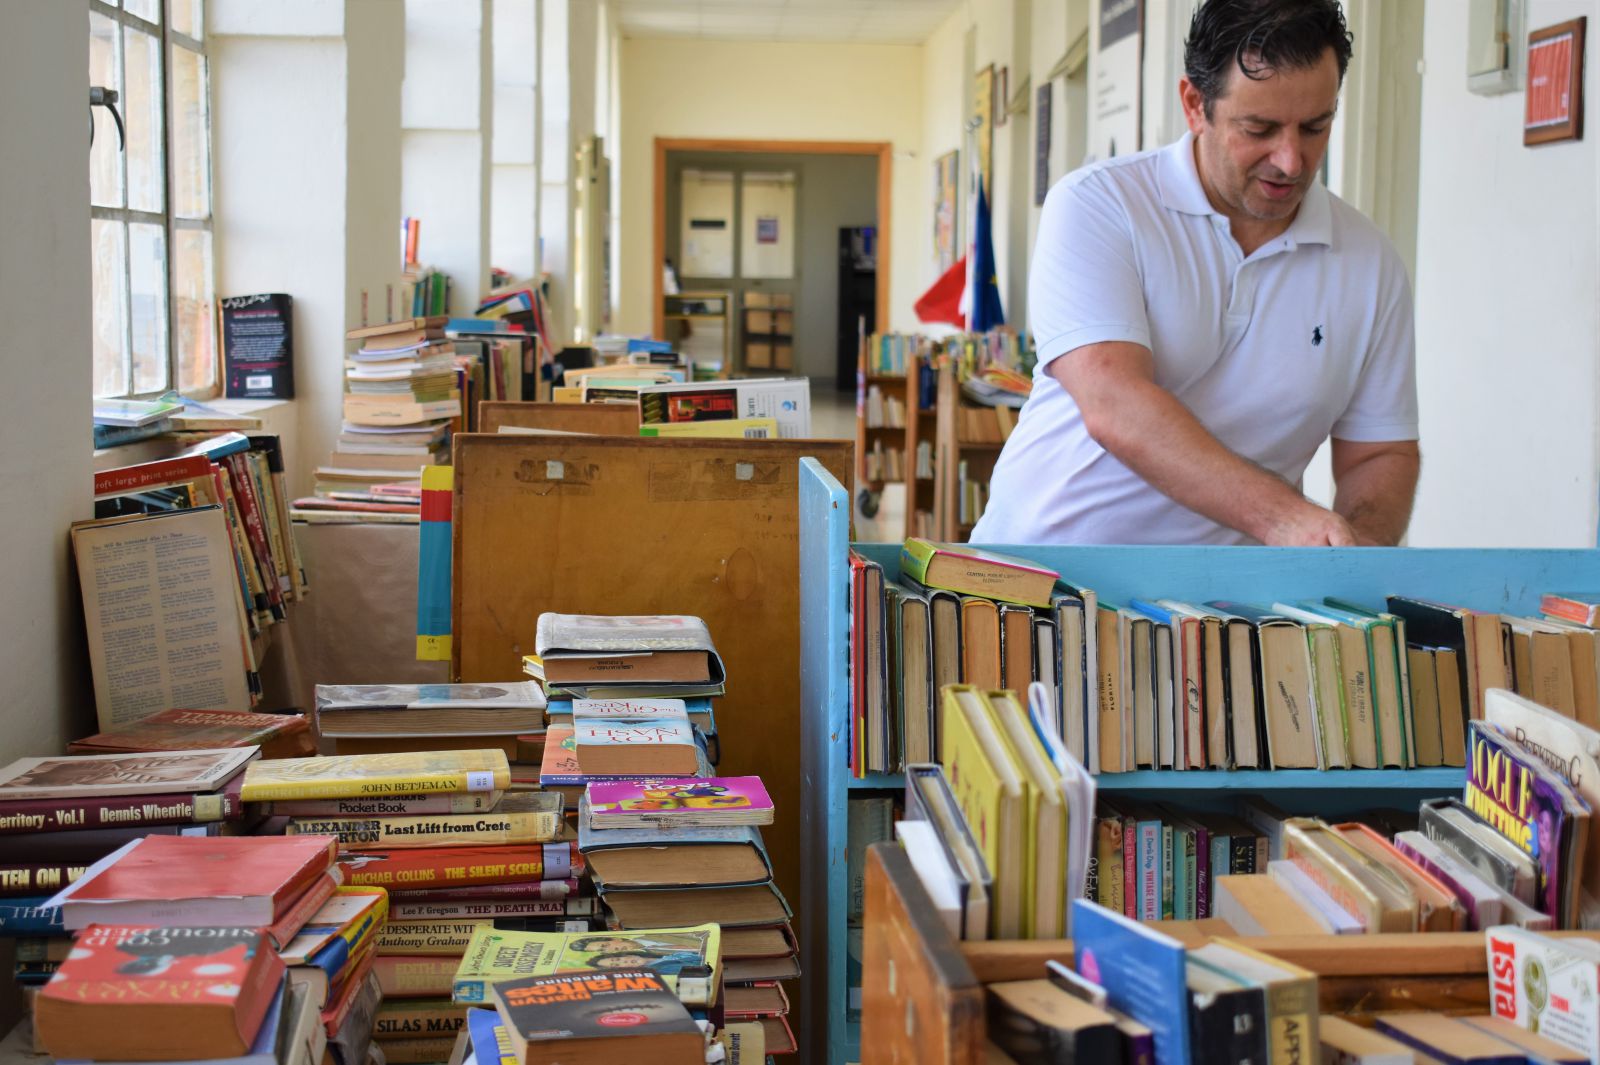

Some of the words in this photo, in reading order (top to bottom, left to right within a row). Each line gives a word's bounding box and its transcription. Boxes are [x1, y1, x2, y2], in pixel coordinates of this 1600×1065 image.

[115, 476, 137, 486] large
[141, 472, 161, 482] print
[590, 727, 680, 737] NASH
[361, 783, 391, 793] JOHN
[394, 779, 457, 792] BETJEMAN
[100, 806, 141, 823] Dennis
[142, 804, 195, 820] Wheatle
[339, 802, 376, 813] Pocket
[378, 802, 406, 813] Book
[385, 824, 414, 835] Last
[417, 821, 440, 834] Lift
[443, 819, 474, 833] from
[476, 819, 511, 832] Crete
[36, 868, 61, 888] ON
[351, 870, 394, 884] MICHAEL
[396, 869, 435, 882] COLLINS
[444, 866, 467, 879] THE
[469, 864, 505, 877] SILENT
[1145, 870, 1154, 897] VINTAGE
[402, 906, 416, 915] Lee
[426, 906, 459, 917] Gregson
[465, 905, 491, 914] THE
[494, 903, 532, 913] DEATH
[93, 927, 259, 939] SHOULDER
[387, 924, 451, 935] DESPERATE
[84, 934, 171, 947] COLD
[378, 936, 429, 948] Anthony
[377, 1018, 421, 1033] SILAS
